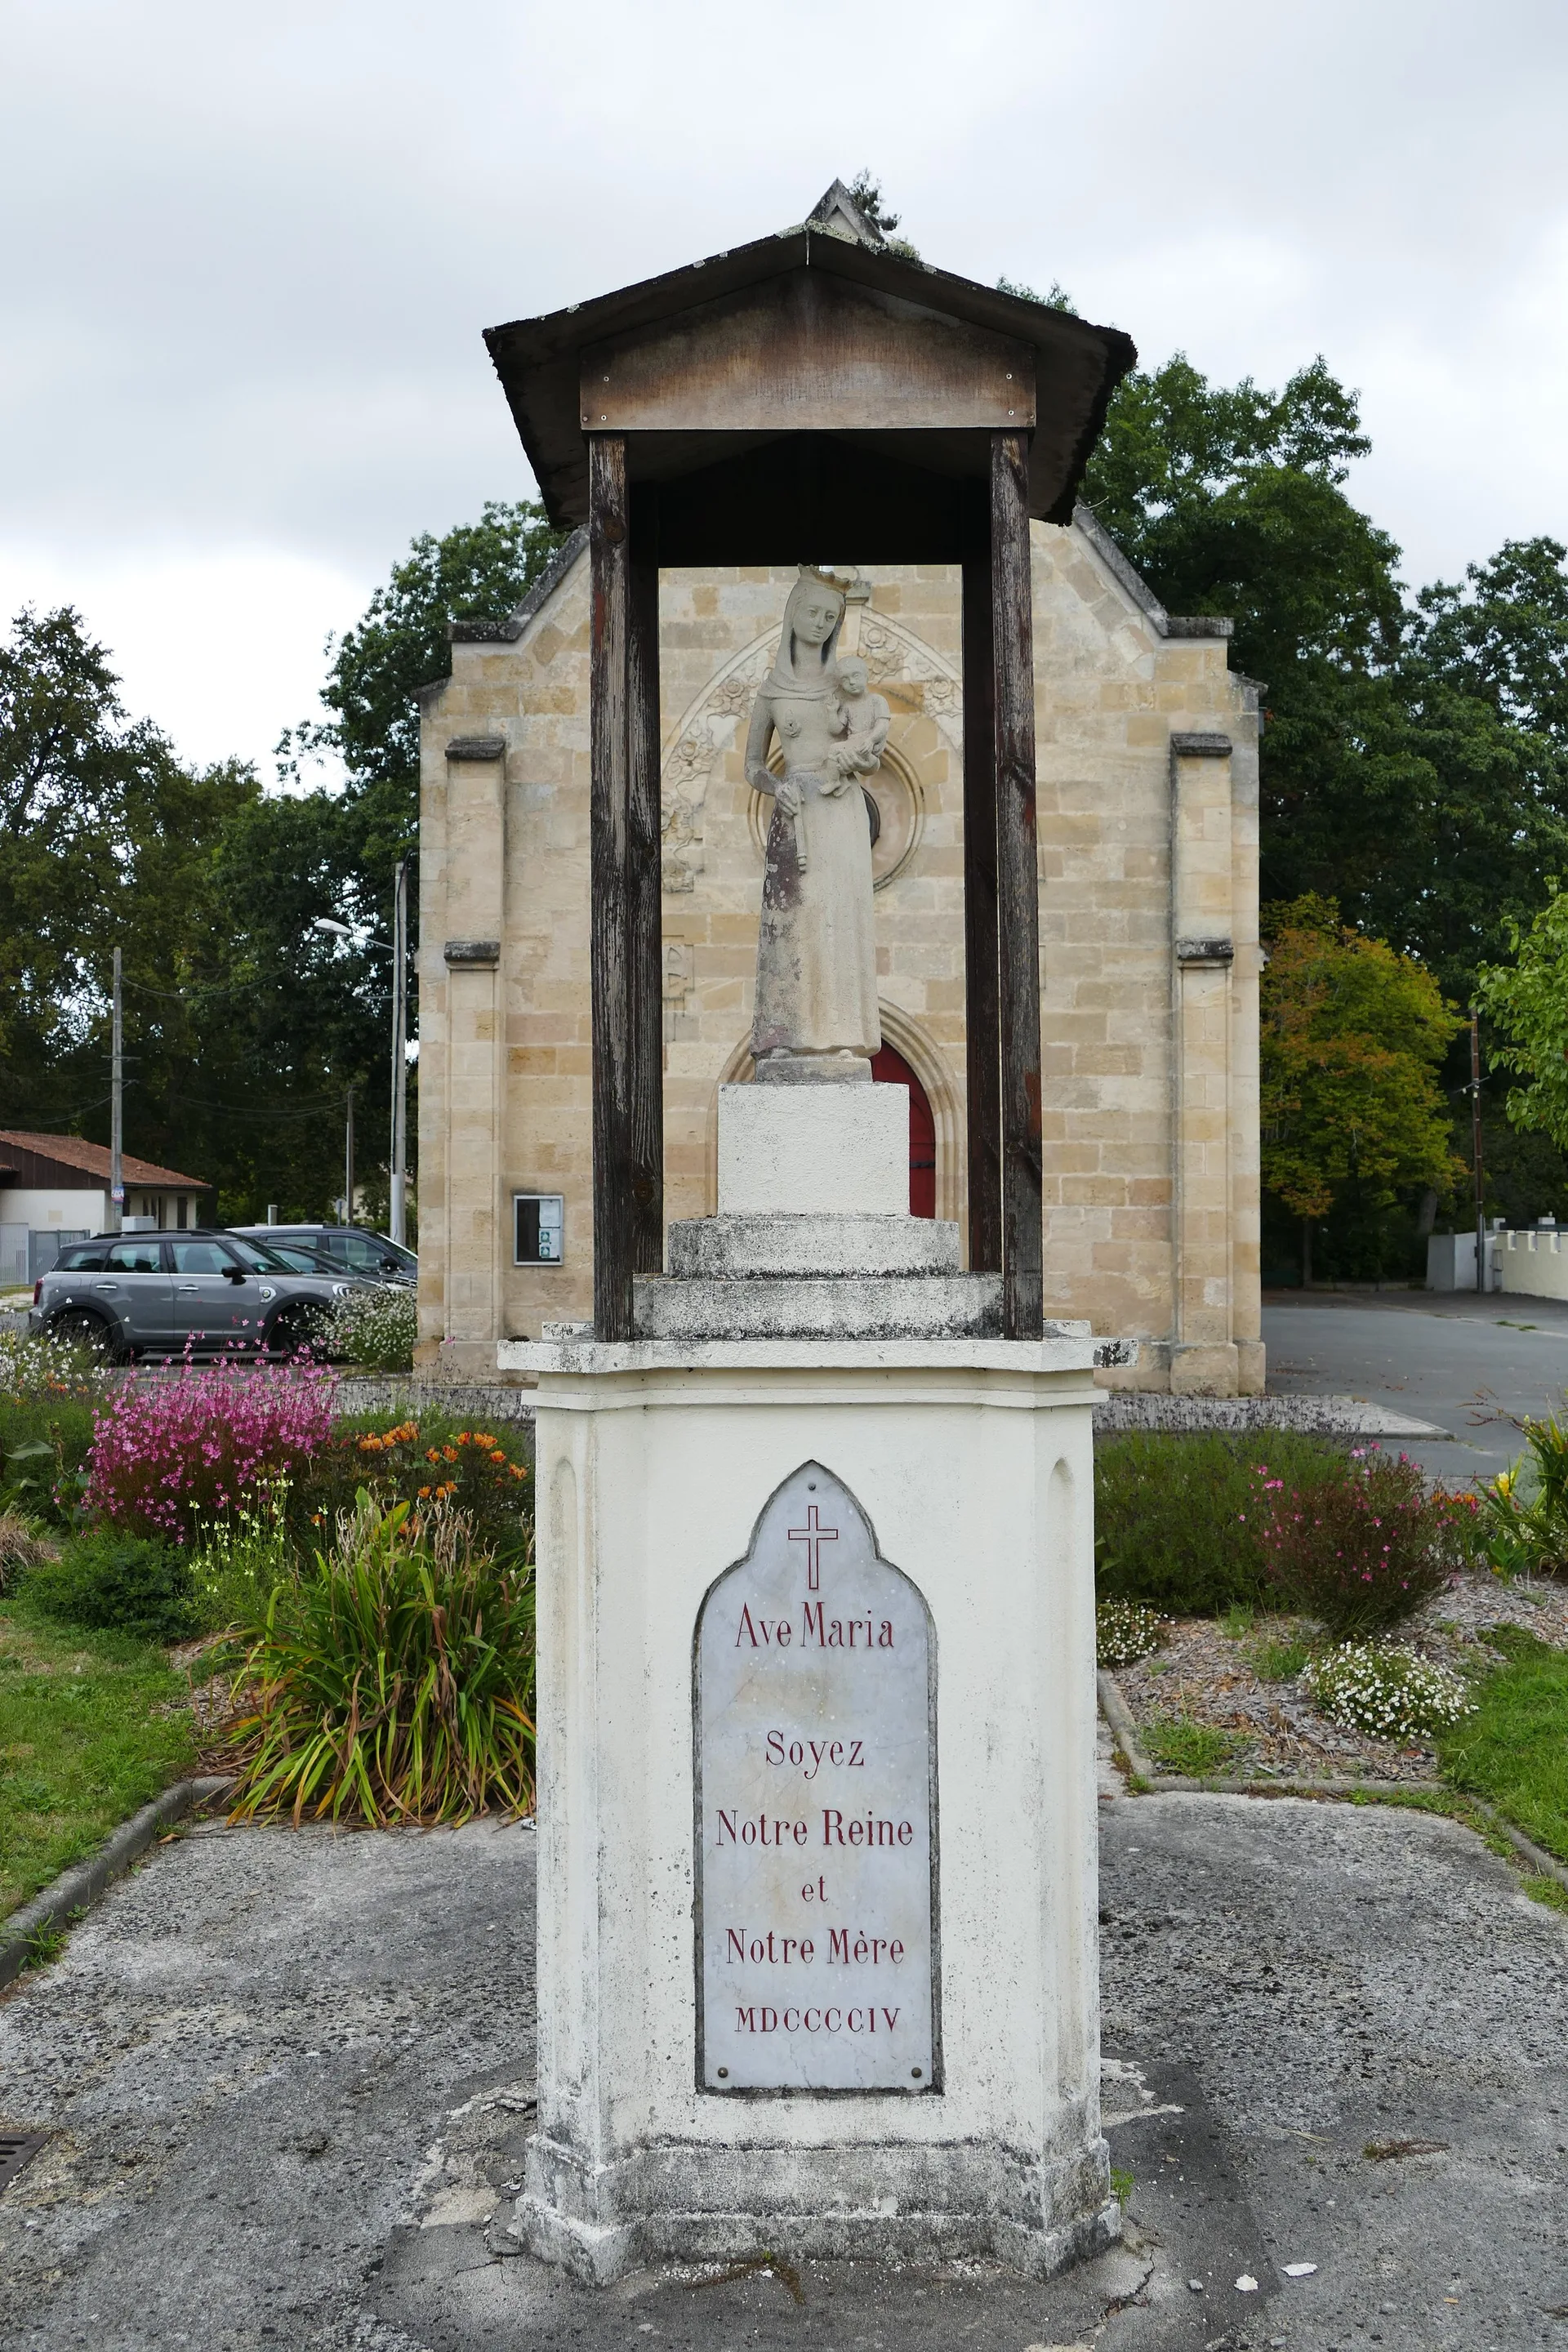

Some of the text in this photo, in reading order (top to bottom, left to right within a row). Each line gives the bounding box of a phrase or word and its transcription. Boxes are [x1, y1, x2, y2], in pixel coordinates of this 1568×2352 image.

[734, 1601, 894, 1648] Ave Maria
[765, 1730, 865, 1779] Soyez
[715, 1809, 913, 1846] Notre Reine
[800, 1875, 828, 1902] et
[725, 1927, 905, 1964] Notre Mère
[734, 2007, 901, 2033] MDCCCCIV
